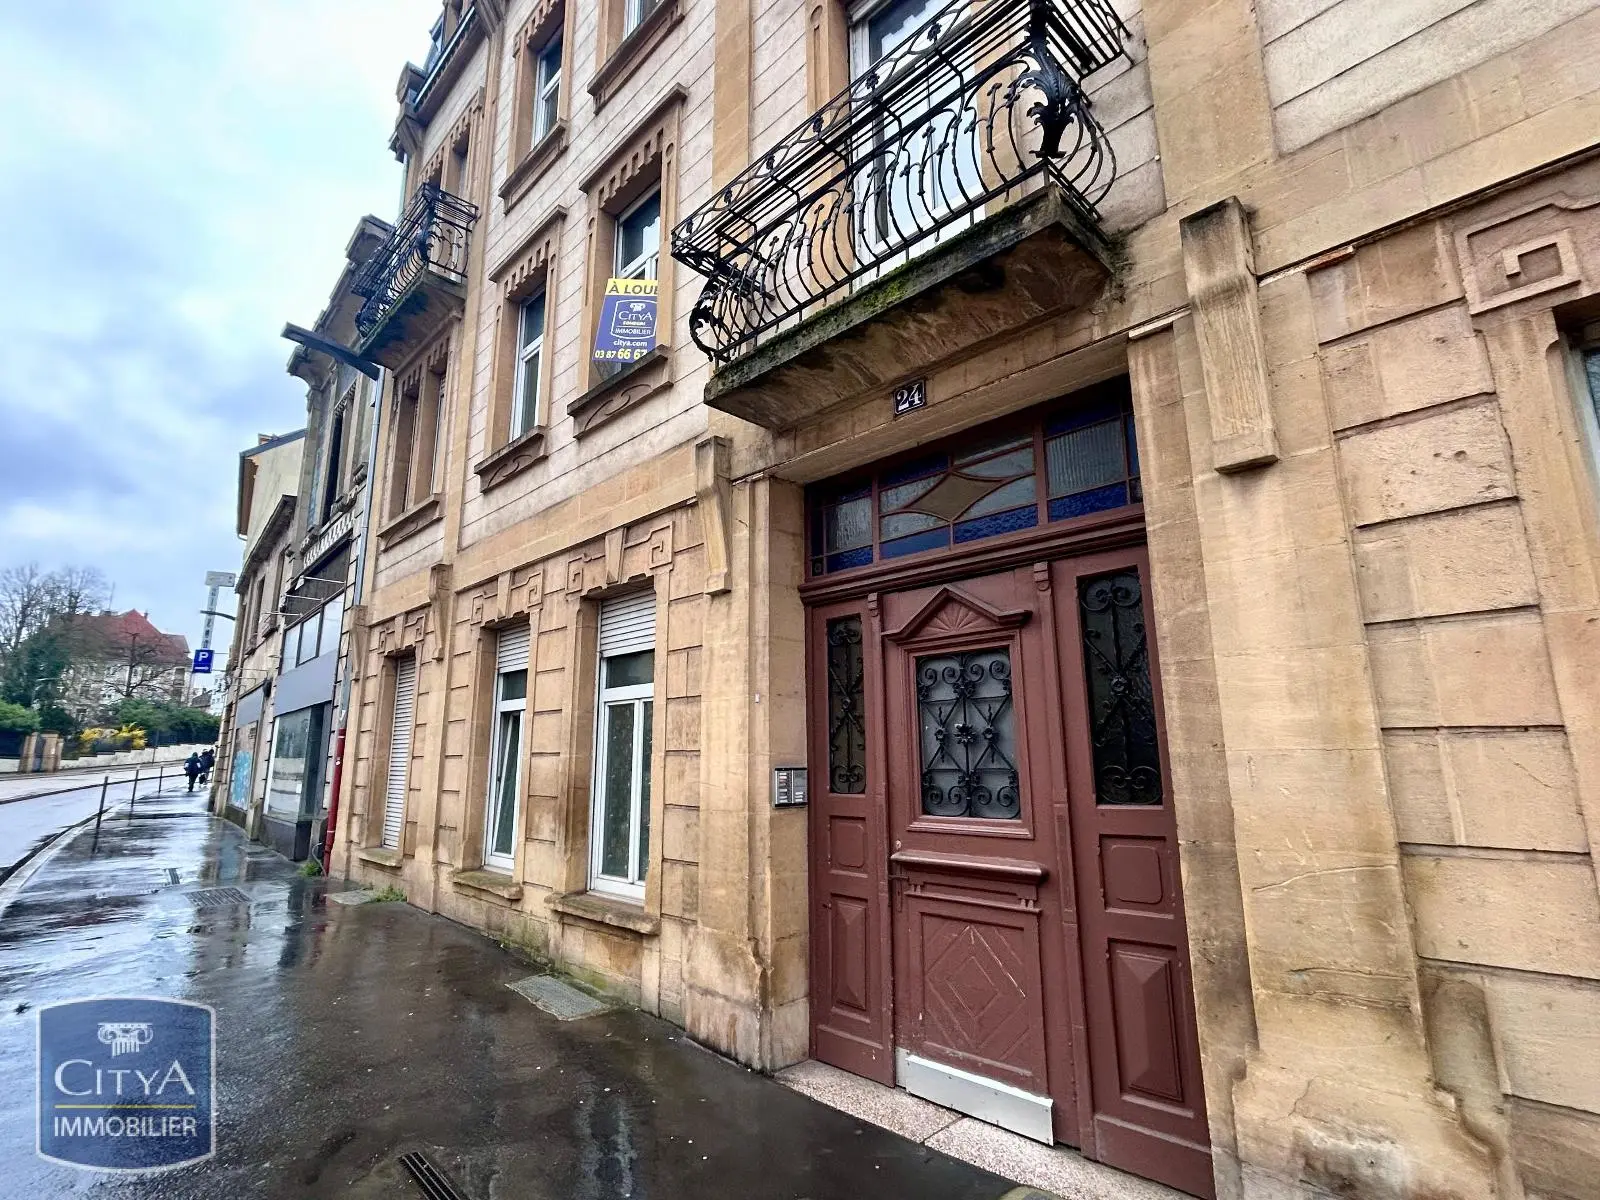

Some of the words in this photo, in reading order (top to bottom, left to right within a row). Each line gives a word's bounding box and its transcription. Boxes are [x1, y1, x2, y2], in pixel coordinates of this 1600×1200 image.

[609, 281, 620, 294] À
[618, 310, 653, 321] CITYA
[615, 327, 651, 335] IMMOBILIER
[613, 339, 648, 347] citya.com
[594, 350, 604, 359] 03
[605, 350, 616, 359] 87
[617, 348, 631, 359] 66
[896, 383, 922, 411] 24
[198, 651, 209, 662] P
